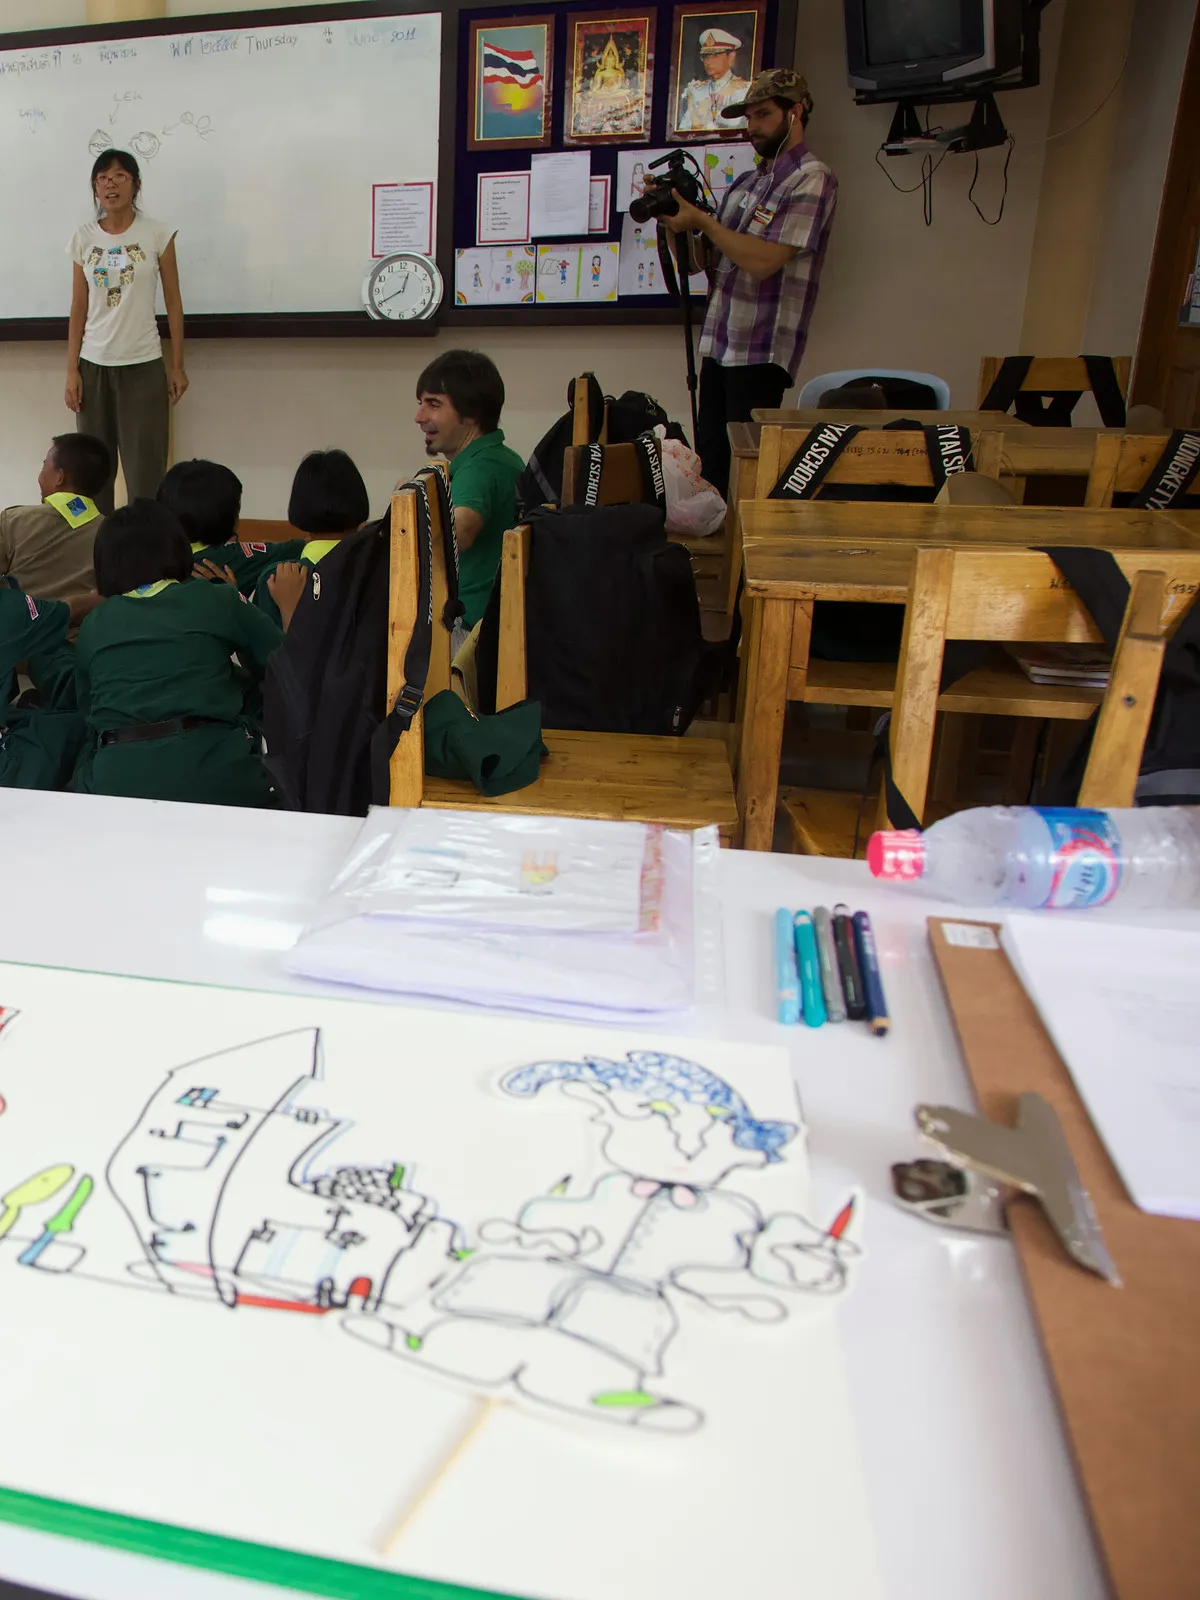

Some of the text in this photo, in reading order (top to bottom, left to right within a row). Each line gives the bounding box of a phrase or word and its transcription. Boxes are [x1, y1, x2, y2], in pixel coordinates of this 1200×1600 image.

[245, 33, 299, 55] Thursday
[390, 27, 416, 42] 2011
[937, 424, 962, 455] TYAI
[585, 462, 602, 507] SCHOOL
[649, 453, 665, 500] SCHOOL
[782, 442, 829, 495] SCHOOL
